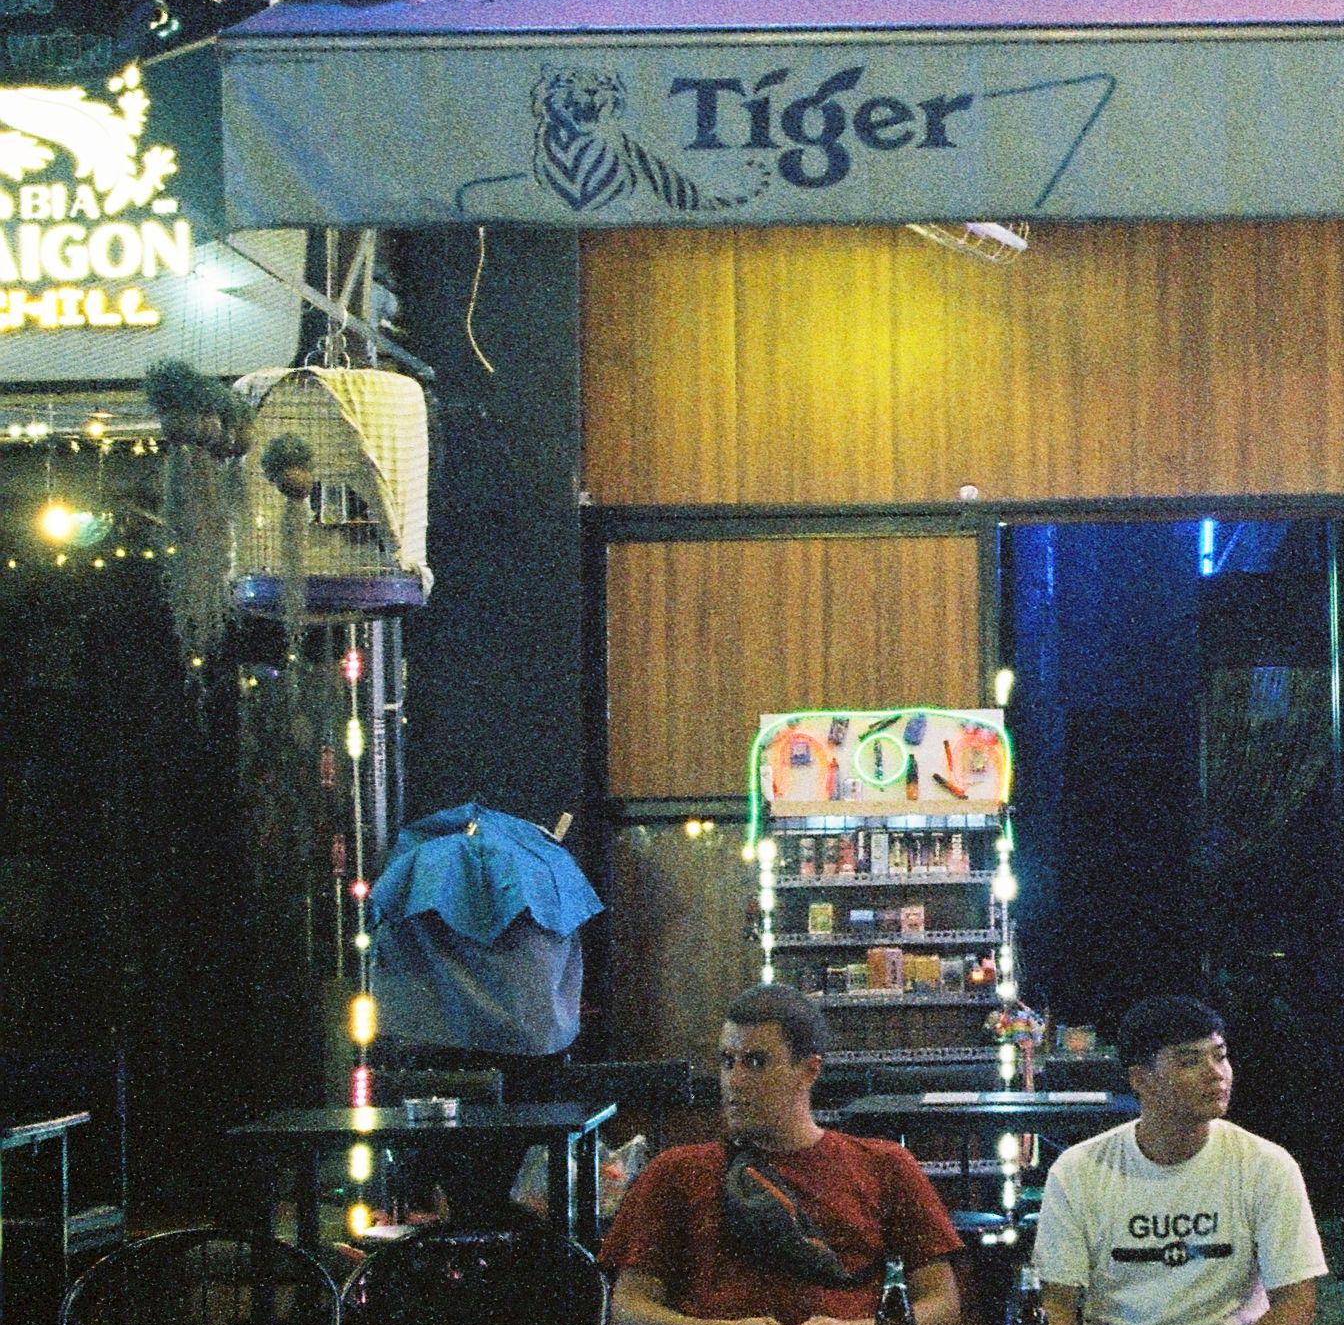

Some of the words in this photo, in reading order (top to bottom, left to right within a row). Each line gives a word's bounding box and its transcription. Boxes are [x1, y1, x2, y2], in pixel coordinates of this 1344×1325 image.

[668, 65, 974, 189] Tiger
[19, 184, 101, 220] BIA
[0, 285, 161, 330] HILL
[1127, 1211, 1219, 1239] GUCCI
